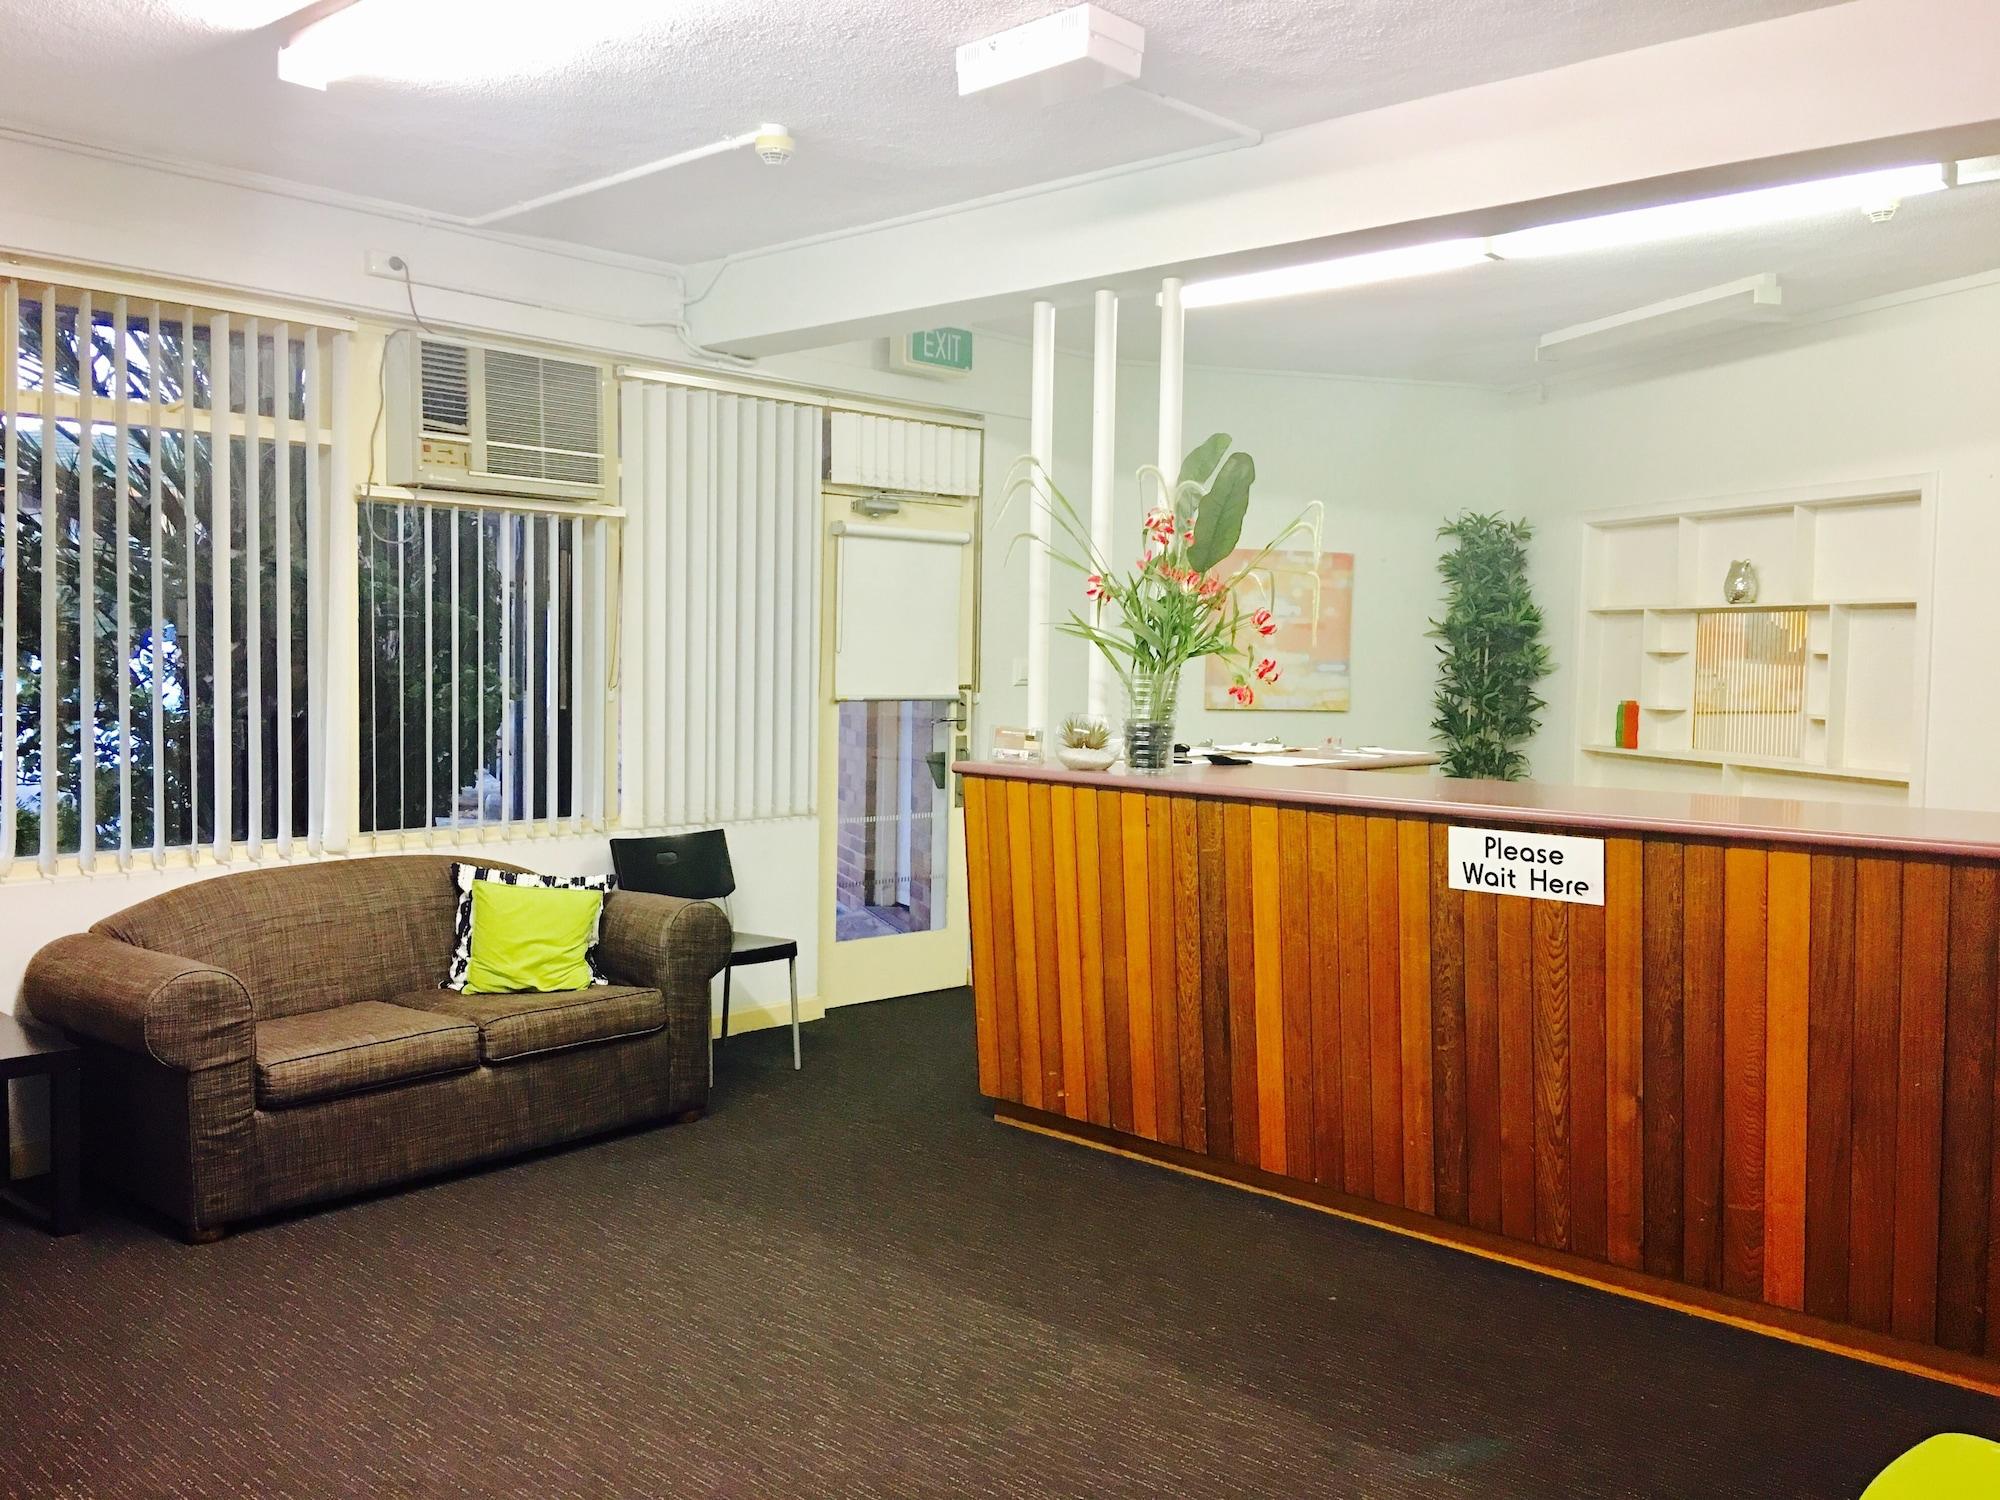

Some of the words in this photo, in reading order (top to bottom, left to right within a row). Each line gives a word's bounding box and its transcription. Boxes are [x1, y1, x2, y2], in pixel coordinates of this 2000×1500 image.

[923, 330, 961, 362] EXIT
[1485, 836, 1564, 865] Please
[1462, 861, 1517, 889] Wait
[1530, 868, 1589, 896] Here
